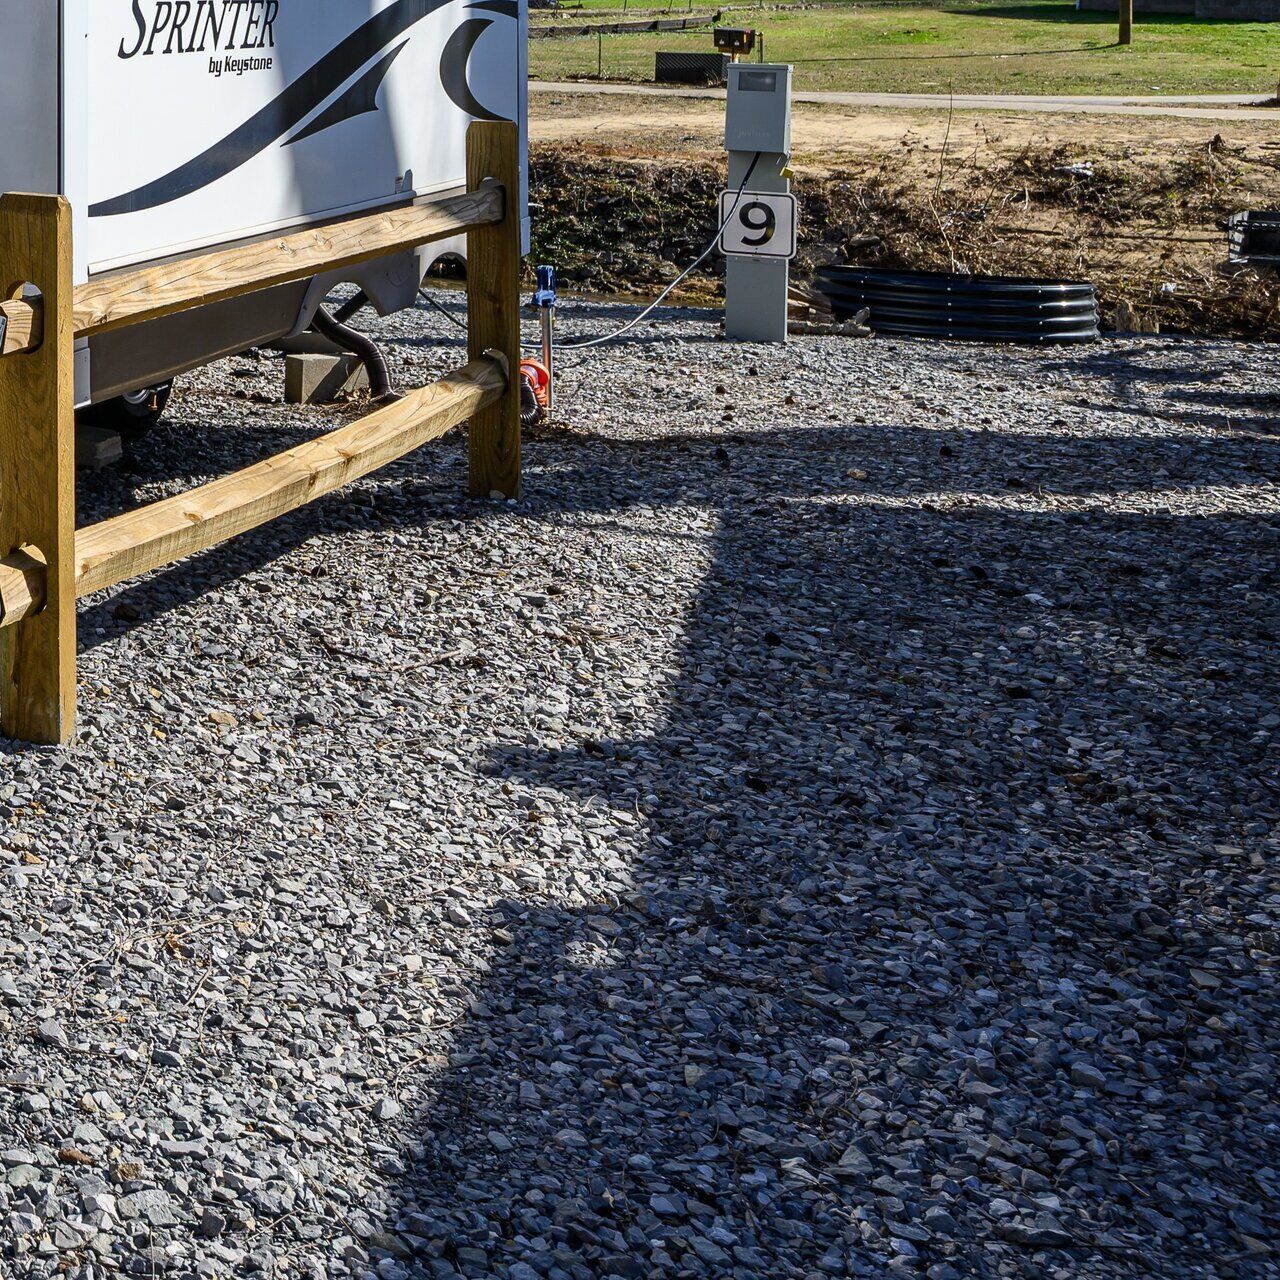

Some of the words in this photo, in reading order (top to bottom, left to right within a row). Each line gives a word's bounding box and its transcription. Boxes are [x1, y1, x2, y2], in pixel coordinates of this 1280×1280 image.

[208, 57, 222, 77] by
[224, 56, 273, 76] Keystone
[739, 201, 776, 247] 9
